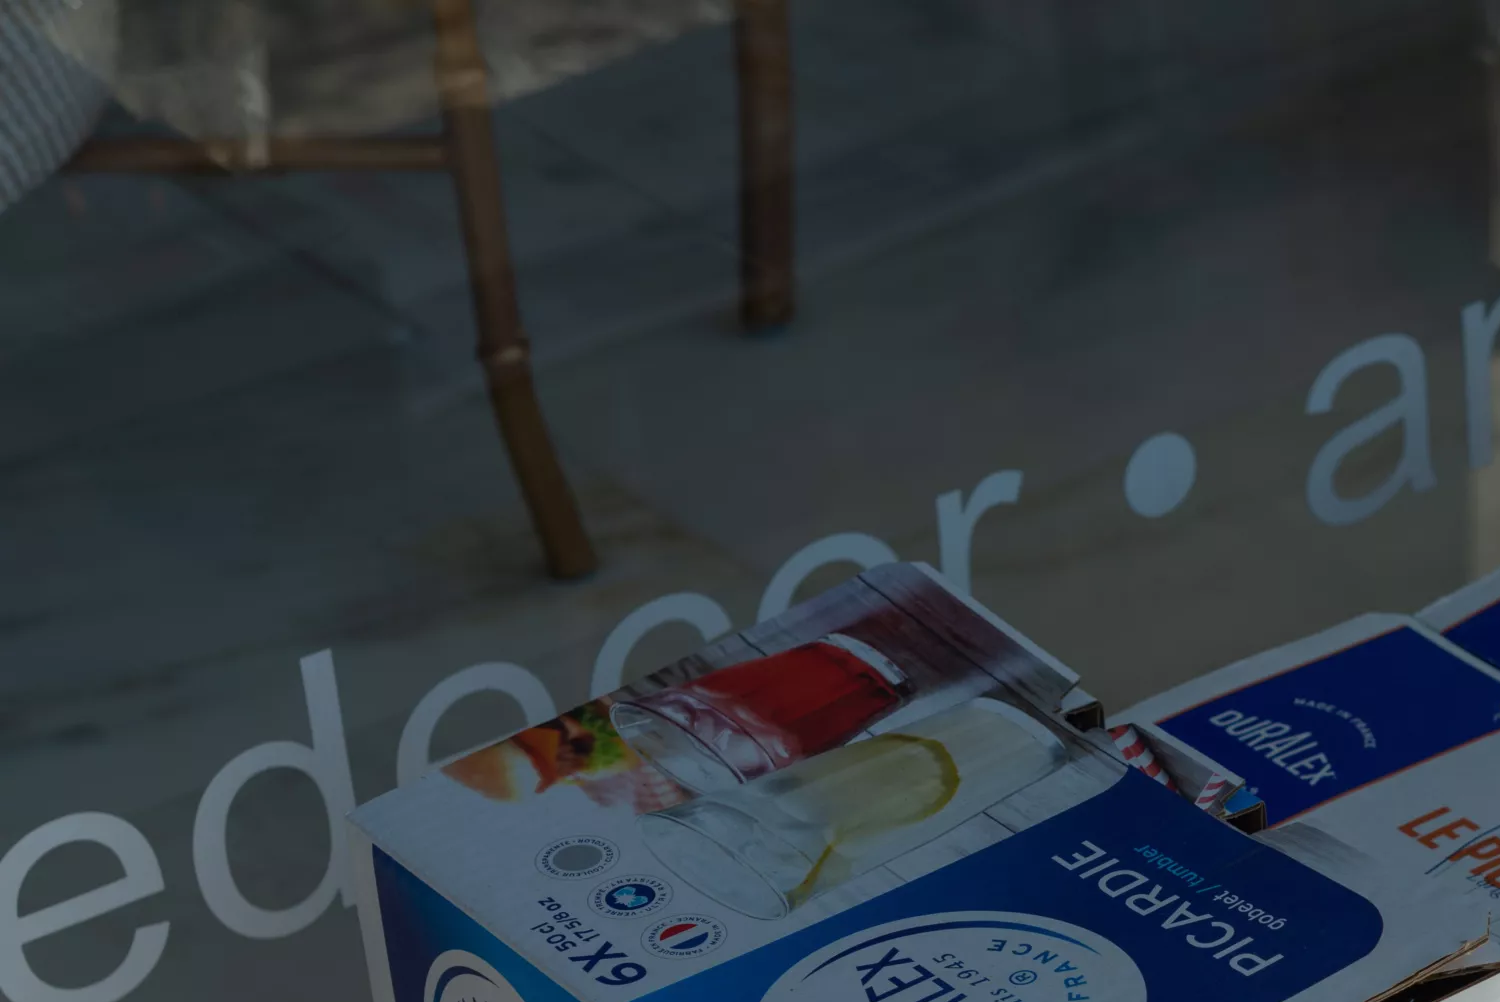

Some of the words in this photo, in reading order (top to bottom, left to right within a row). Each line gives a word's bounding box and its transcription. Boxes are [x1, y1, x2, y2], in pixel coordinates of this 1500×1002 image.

[1208, 709, 1336, 787] DURALEX
[1397, 806, 1480, 850] LE
[1133, 844, 1203, 890] tumbler
[1049, 839, 1285, 977] PICARDIE
[1214, 892, 1285, 931] gobelet
[573, 928, 600, 942] 17
[568, 941, 647, 985] 6X
[933, 953, 991, 986] 1945
[986, 937, 1089, 1002] FRANCE
